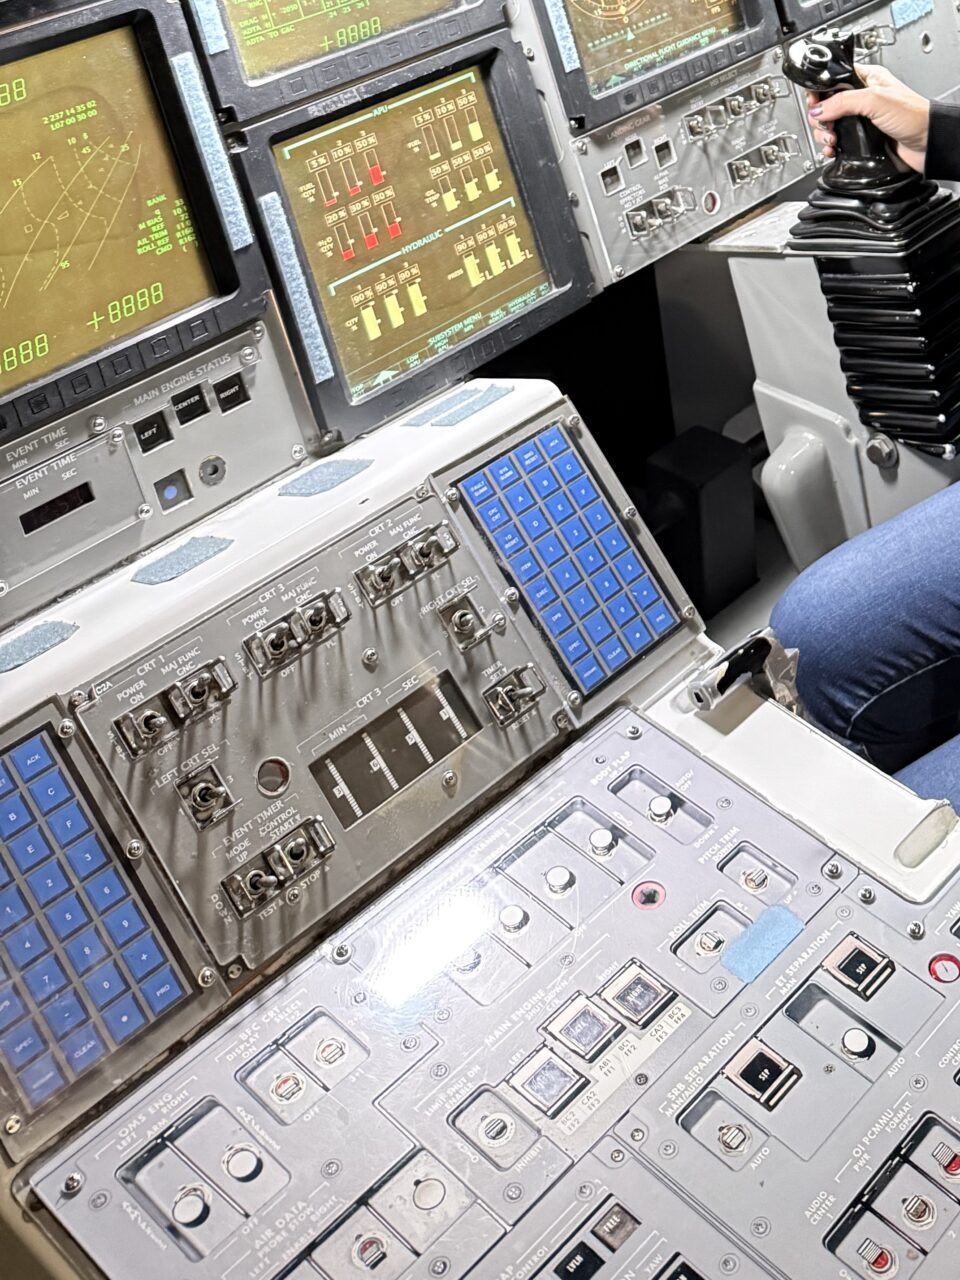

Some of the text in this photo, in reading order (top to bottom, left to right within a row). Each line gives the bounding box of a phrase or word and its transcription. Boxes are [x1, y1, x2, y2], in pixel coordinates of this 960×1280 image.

[372, 104, 389, 118] APU
[32, 152, 42, 161] 12
[12, 178, 23, 188] 15
[401, 228, 444, 255] HYDRAULIC
[133, 353, 232, 407] MAIN ENGINE STATUS
[174, 394, 200, 411] CENTER
[219, 385, 240, 400] RIGHT
[6, 425, 68, 463] EVENT TIME
[12, 437, 70, 471] MIN SEC
[15, 453, 78, 490] EVENT TIME
[23, 468, 78, 500] MIN SEC
[368, 518, 393, 538] CRT 2
[389, 513, 423, 537] MAJ FUNC
[402, 526, 419, 539] GNC
[354, 540, 379, 558] POWER
[365, 551, 378, 562] ON
[259, 583, 285, 604] CRT 3
[295, 590, 313, 604] GNC
[242, 606, 269, 625] POWER
[253, 617, 267, 629] ON
[136, 654, 165, 676] CRT 1
[160, 646, 201, 676] MAJ FUNC
[176, 660, 196, 677] GNC
[95, 680, 113, 695] C2A
[116, 679, 148, 702] POWER
[401, 675, 420, 691] SEC
[129, 692, 145, 705] ON
[356, 688, 383, 709] CRT 3
[328, 724, 348, 742] MIN
[27, 754, 41, 766] ACK
[155, 743, 220, 789] LEFT CRT SEL
[223, 799, 285, 846] EVENT TIMER
[225, 806, 298, 860] MODE CONTROL
[269, 818, 296, 841] START
[698, 825, 741, 865] PITCH TRIM
[236, 851, 248, 863] UP
[300, 870, 321, 889] STOP
[257, 902, 278, 921] TEST
[668, 899, 710, 941] ROLL TRIM
[774, 929, 833, 988] ET SEPARATION
[855, 962, 867, 975] SEP
[156, 984, 171, 997] PRO
[779, 977, 798, 996] MAN
[483, 989, 547, 1047] MAIN ENGINE
[649, 1023, 664, 1038] CA3
[226, 1032, 261, 1062] DISPLAY
[667, 1029, 737, 1102] SRB SEPARATION
[887, 1056, 907, 1079] AUTO
[663, 1076, 705, 1118] MAN/AUTO
[116, 1089, 190, 1151] LEFT RIGHT
[118, 1091, 173, 1139] OMS ENG
[884, 1101, 913, 1134] FORMAT
[898, 1113, 915, 1131] GPC
[145, 1117, 168, 1139] ARM
[851, 1108, 895, 1158] OI PCMMU
[515, 1143, 545, 1173] INHIBIT
[852, 1152, 871, 1172] PWR
[804, 1190, 828, 1218] AUDIO
[810, 1194, 837, 1225] CENTER
[253, 1200, 308, 1251] AIR DATA
[256, 1207, 316, 1259] PROBE STOW
[602, 1215, 621, 1233] FREE
